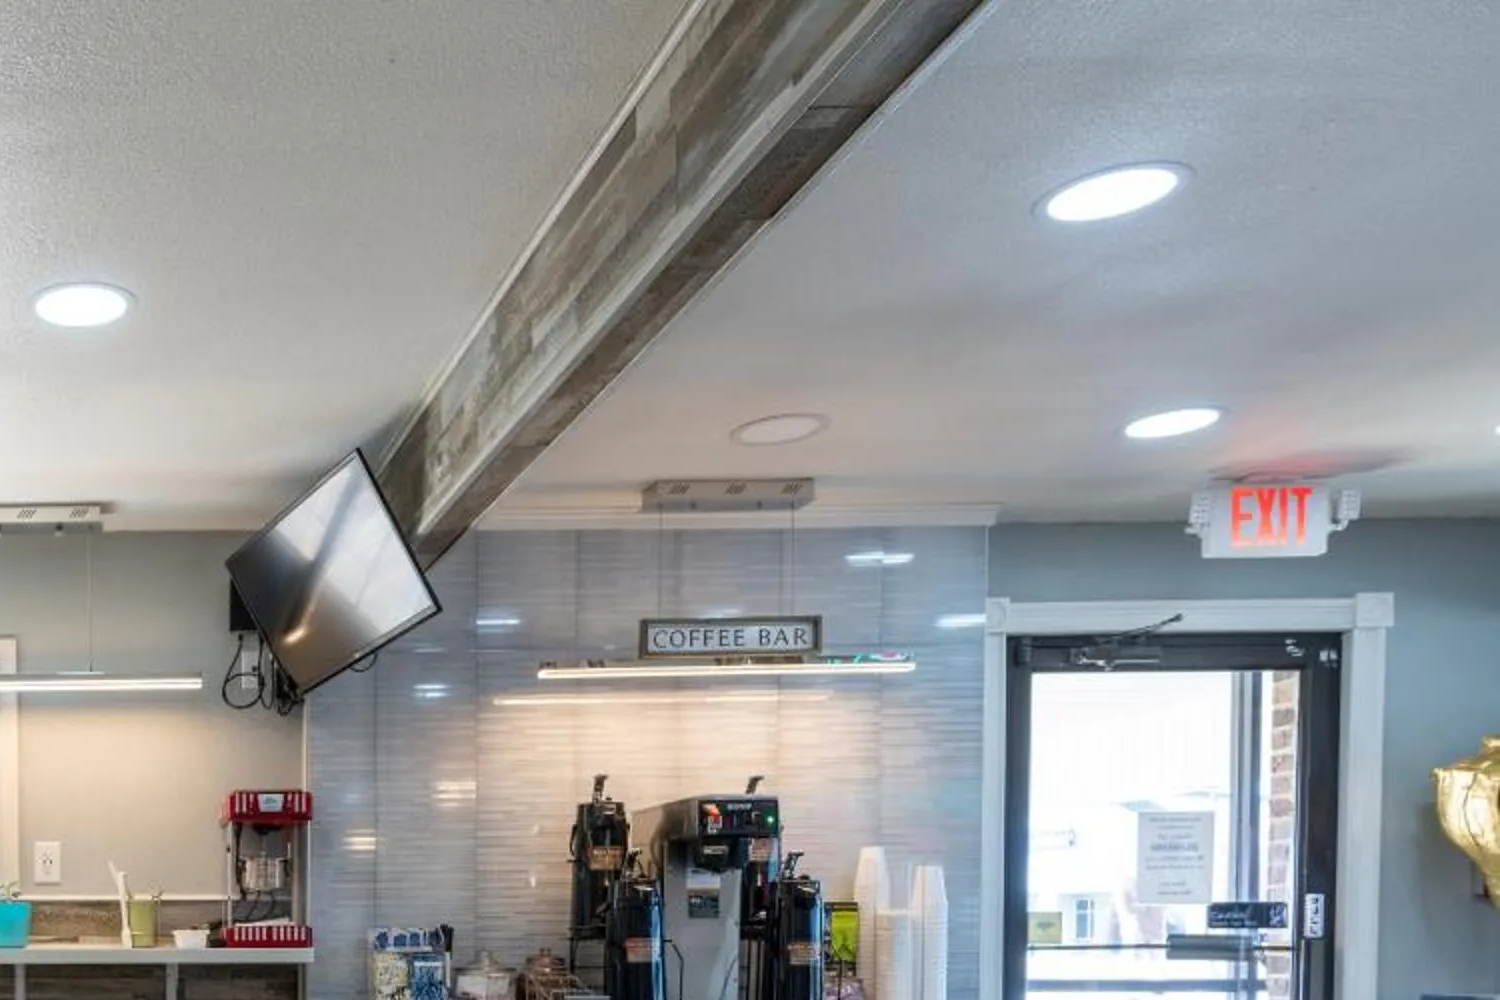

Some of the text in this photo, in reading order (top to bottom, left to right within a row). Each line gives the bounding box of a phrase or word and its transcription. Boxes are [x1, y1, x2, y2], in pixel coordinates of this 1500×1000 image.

[1230, 487, 1313, 545] EXIT
[653, 627, 807, 648] COFFEE BAR
